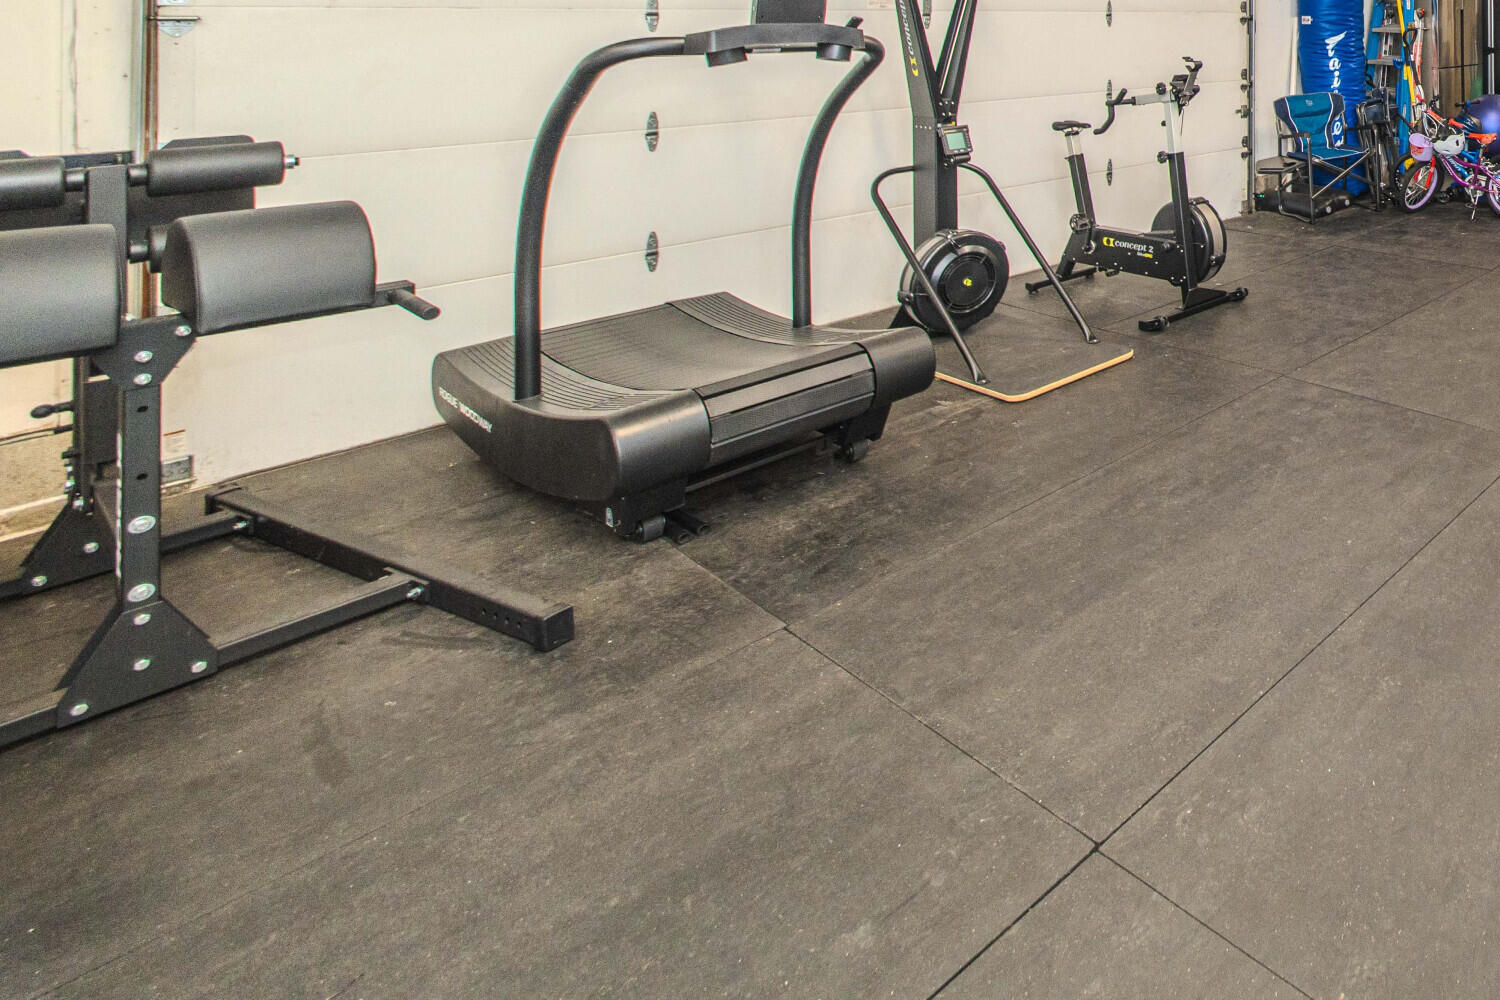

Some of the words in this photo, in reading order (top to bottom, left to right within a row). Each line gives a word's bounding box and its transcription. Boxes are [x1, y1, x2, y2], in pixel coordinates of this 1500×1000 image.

[1114, 240, 1147, 253] concept
[1148, 245, 1154, 253] 2
[438, 386, 459, 409] ROGUE
[459, 400, 493, 433] WOODWAY
